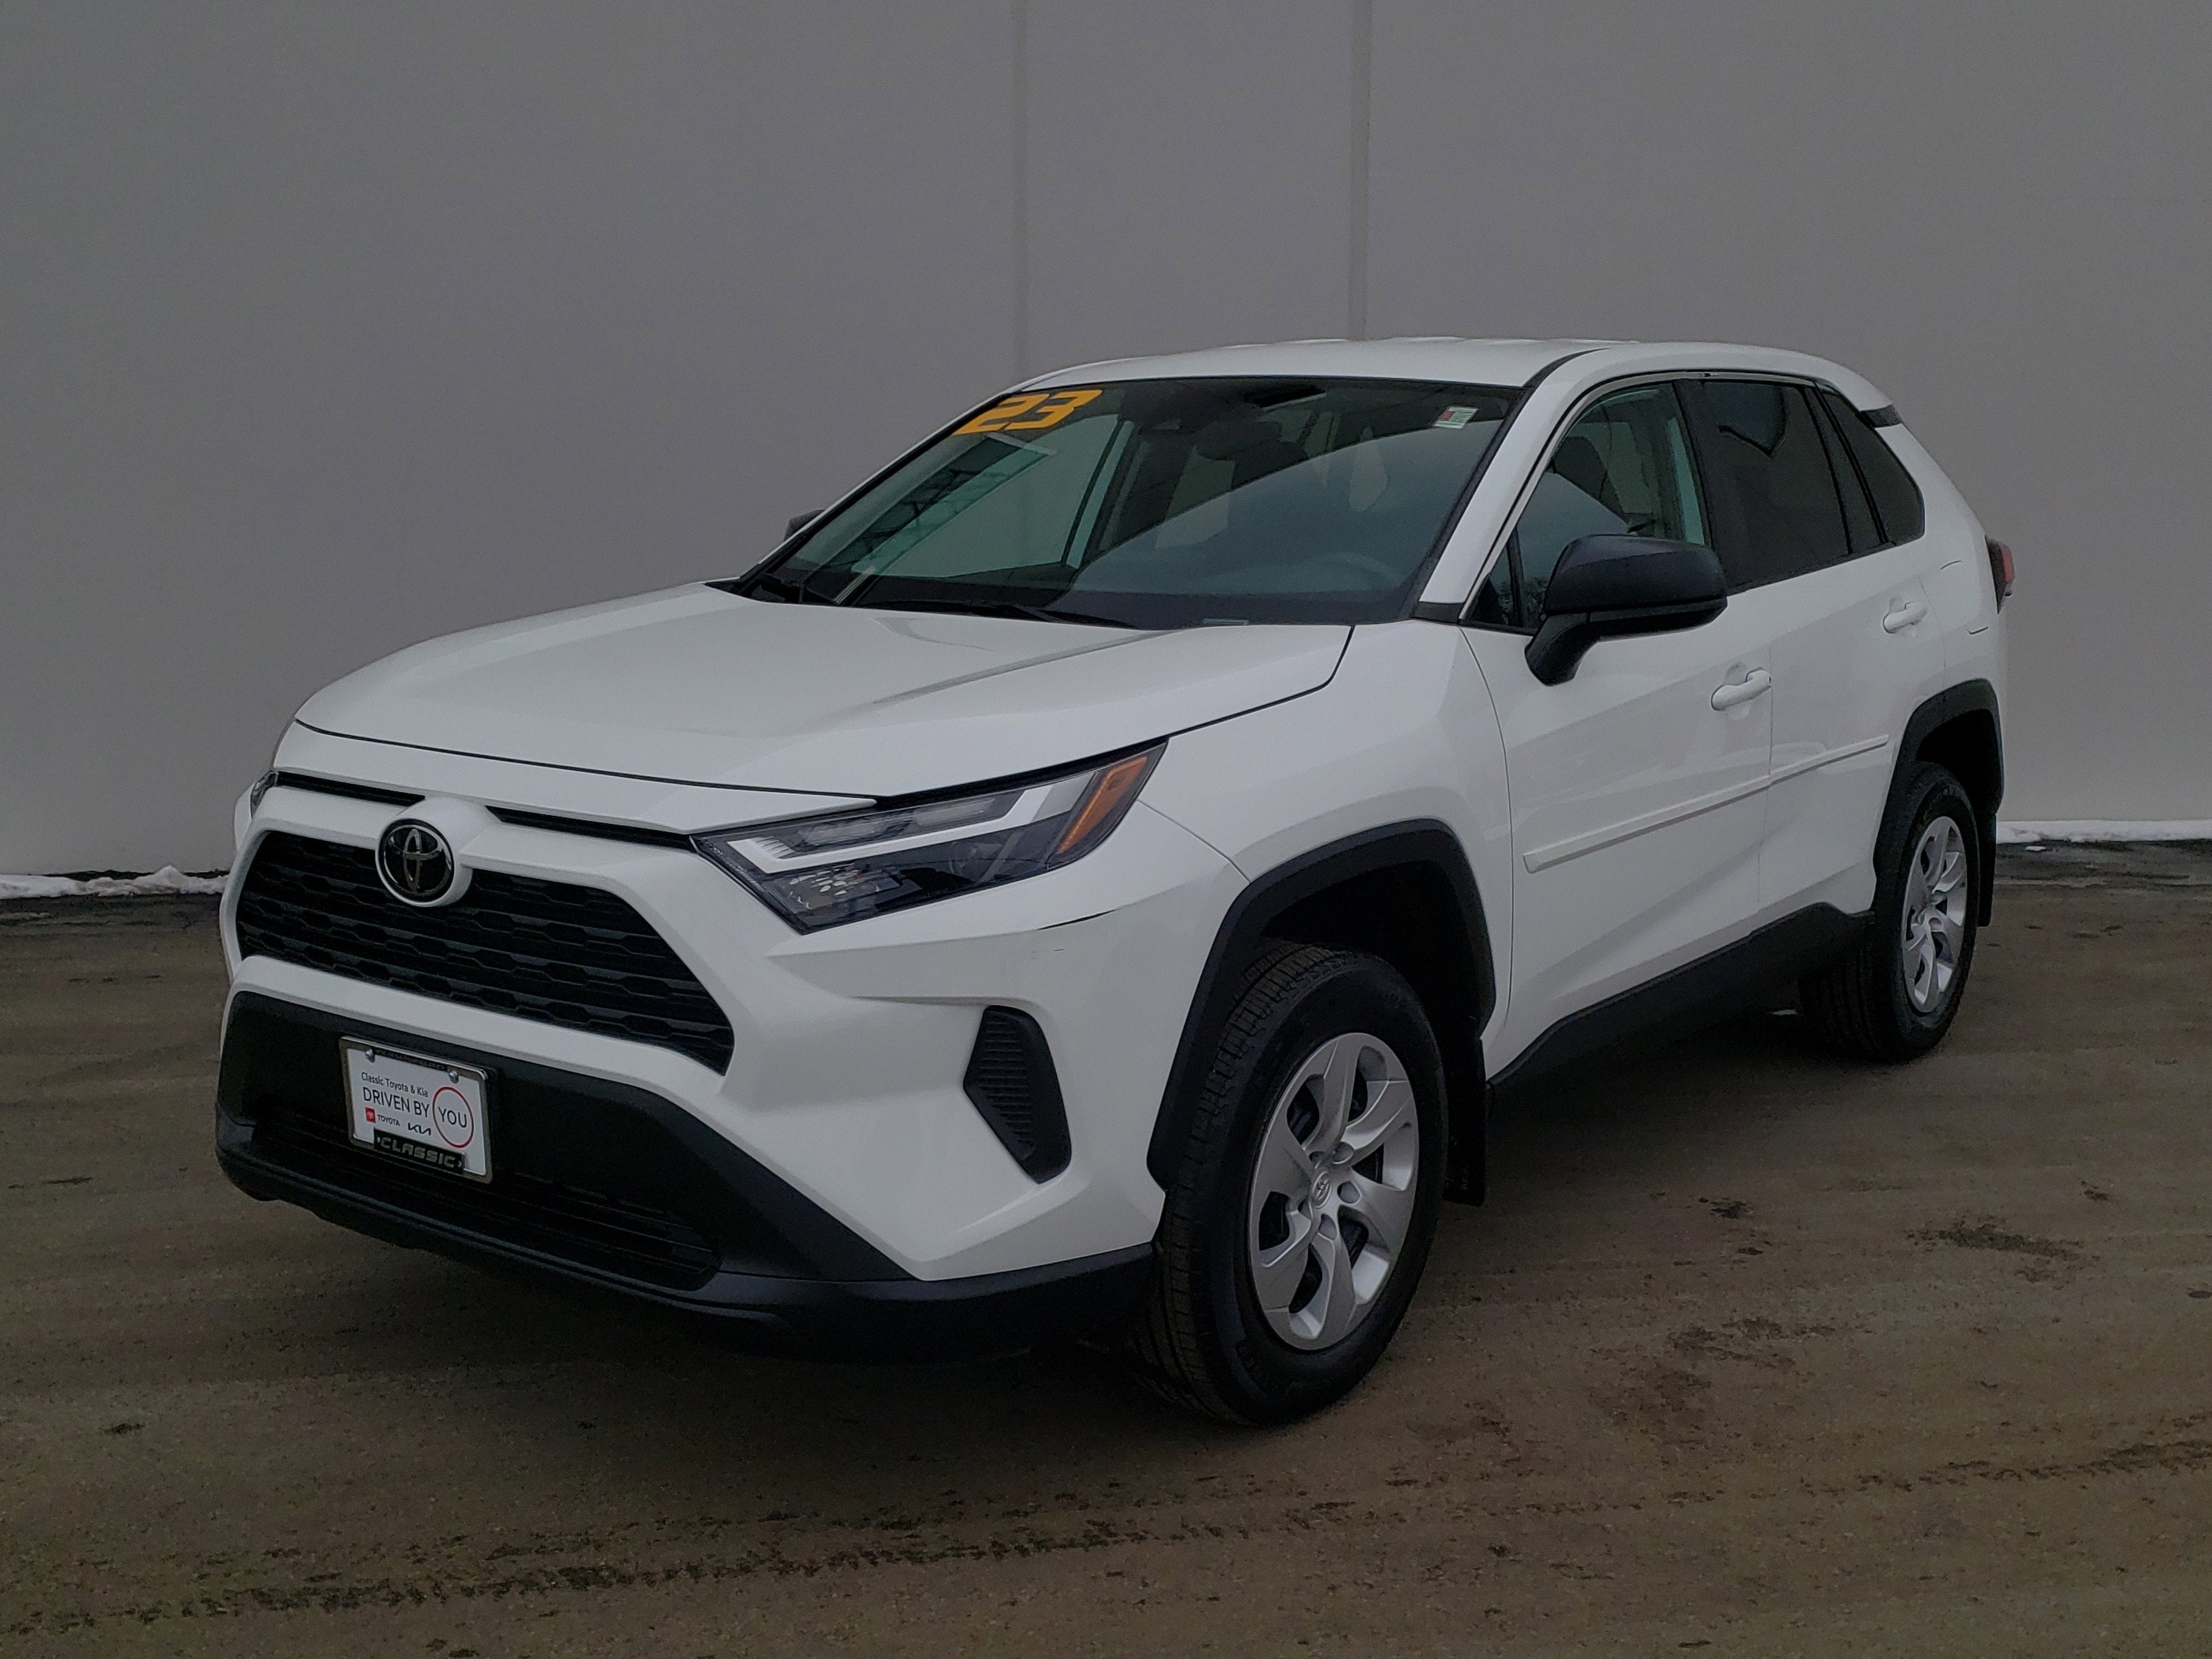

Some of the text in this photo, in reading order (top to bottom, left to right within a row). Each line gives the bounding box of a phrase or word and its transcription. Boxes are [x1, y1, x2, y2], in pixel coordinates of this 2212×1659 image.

[952, 389, 1103, 436] 23
[361, 1071, 384, 1086] Classic
[385, 1078, 409, 1093] Toyota
[417, 1087, 428, 1097] Kia
[363, 1086, 467, 1128] DRIVEN BY YOU
[377, 1114, 400, 1127] TOYOTA
[381, 1137, 456, 1168] CLASSIC
